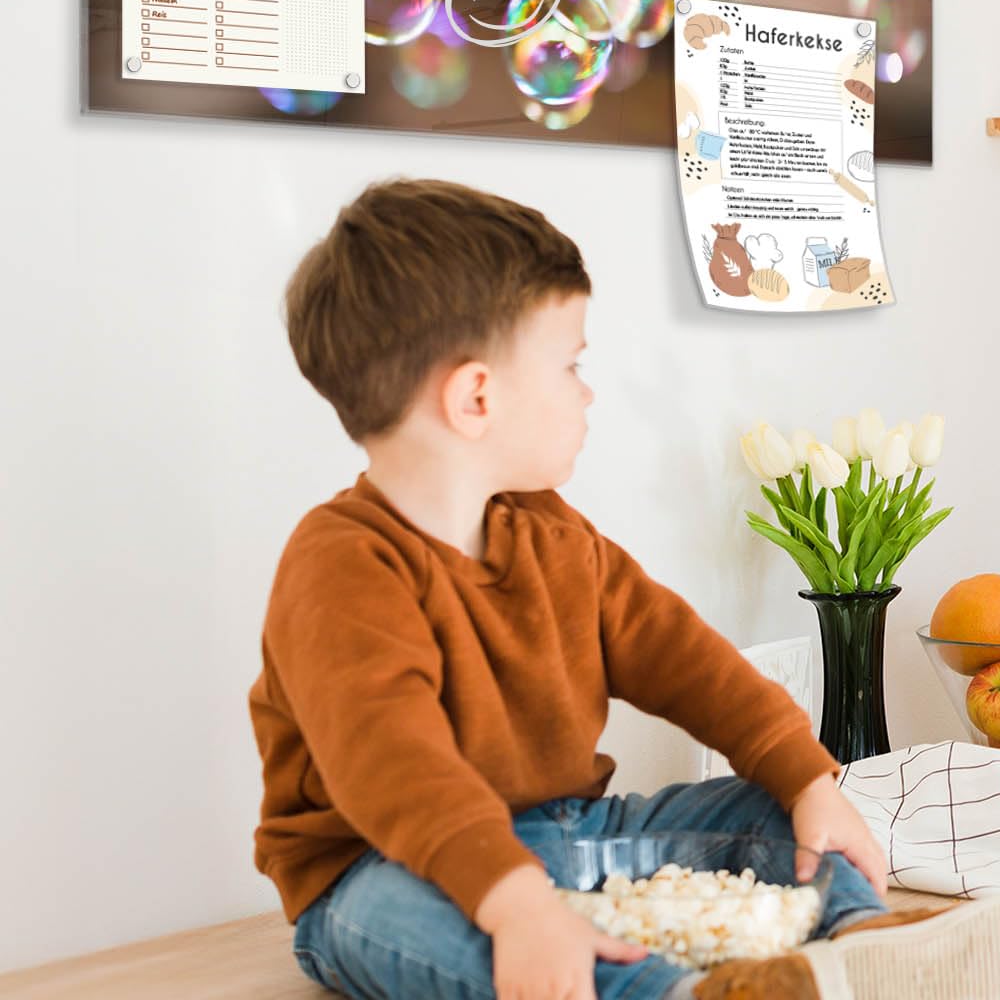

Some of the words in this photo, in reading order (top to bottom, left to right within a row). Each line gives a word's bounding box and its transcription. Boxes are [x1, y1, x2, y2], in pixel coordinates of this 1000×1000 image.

[152, 10, 167, 18] Reis
[745, 23, 843, 52] Haferkekse
[720, 45, 744, 55] Zutaten
